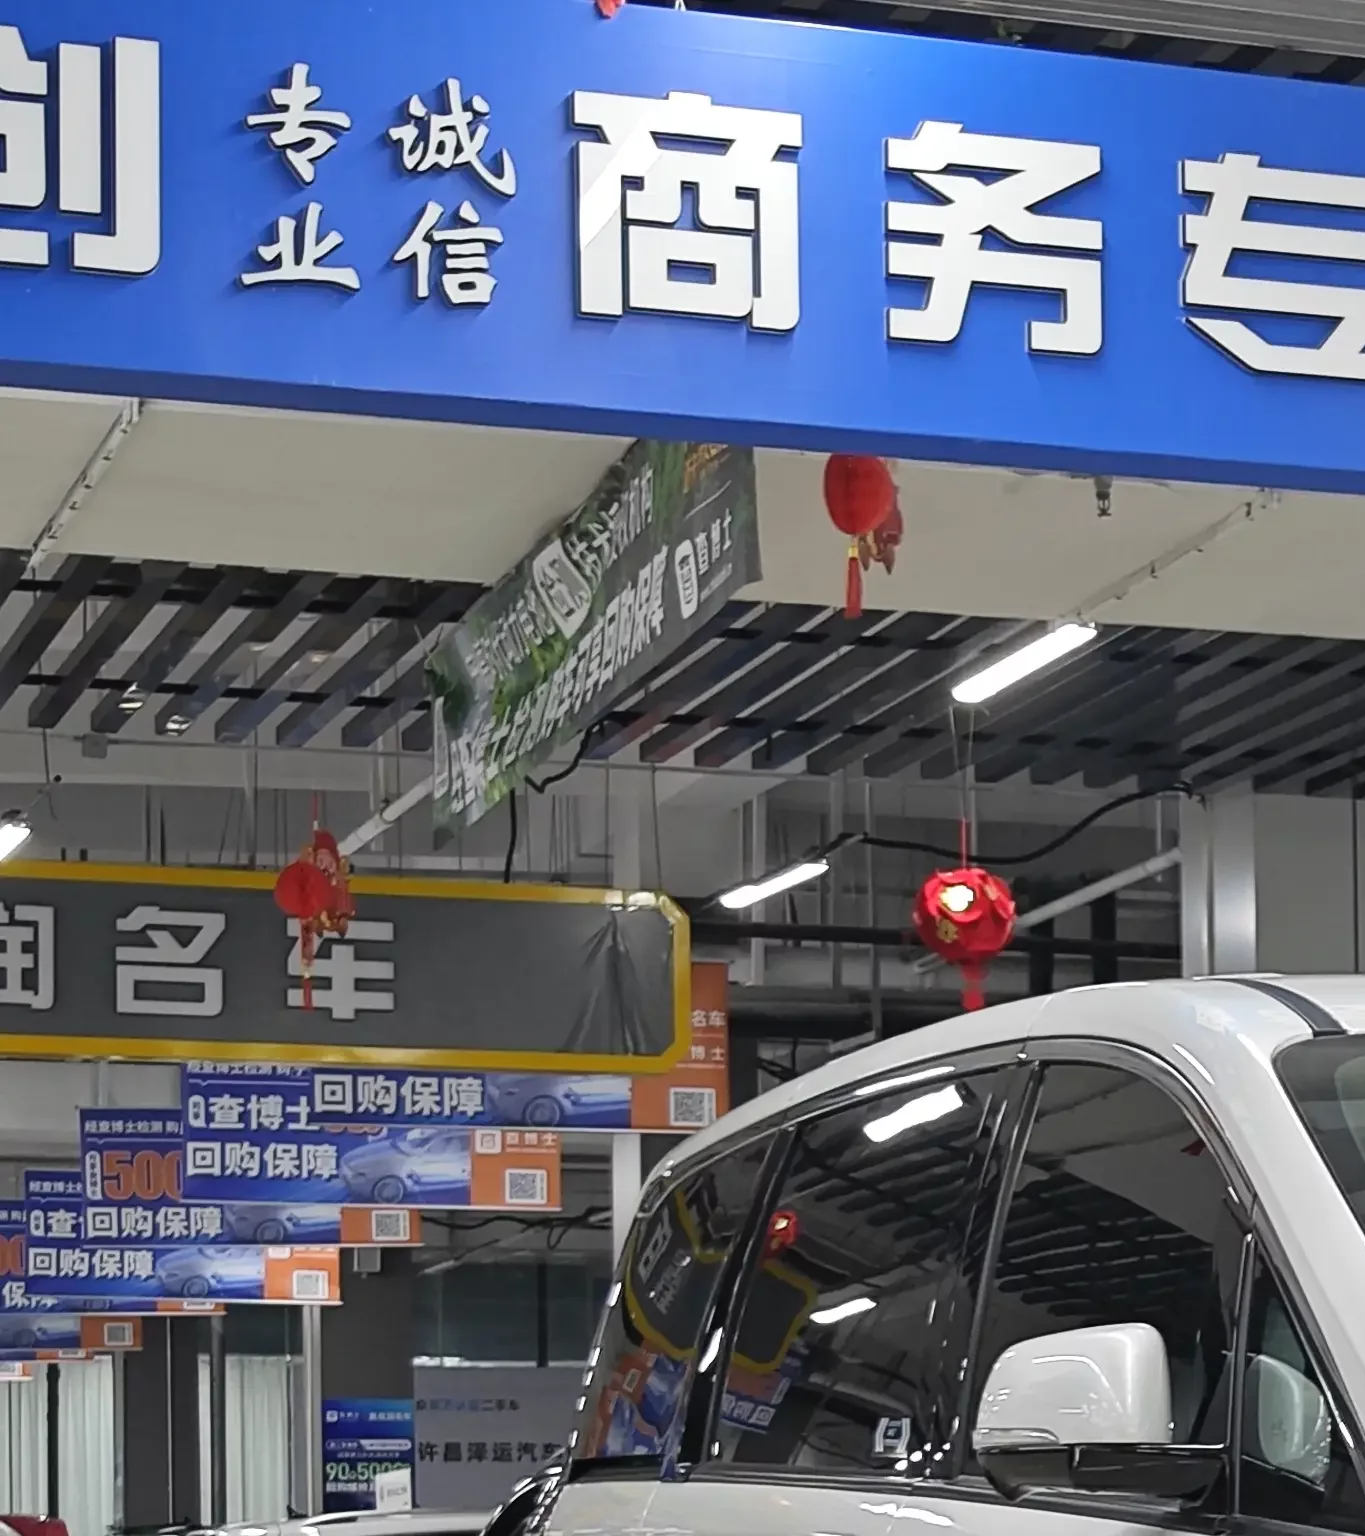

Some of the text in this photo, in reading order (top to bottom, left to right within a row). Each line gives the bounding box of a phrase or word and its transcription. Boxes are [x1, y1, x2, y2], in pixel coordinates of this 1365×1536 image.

[208, 1094, 320, 1131] 查博士
[313, 1073, 484, 1117] 回购保障
[186, 1142, 338, 1181] 回购保障
[86, 1206, 224, 1239] 回购保障
[28, 1247, 154, 1280] 回购保障
